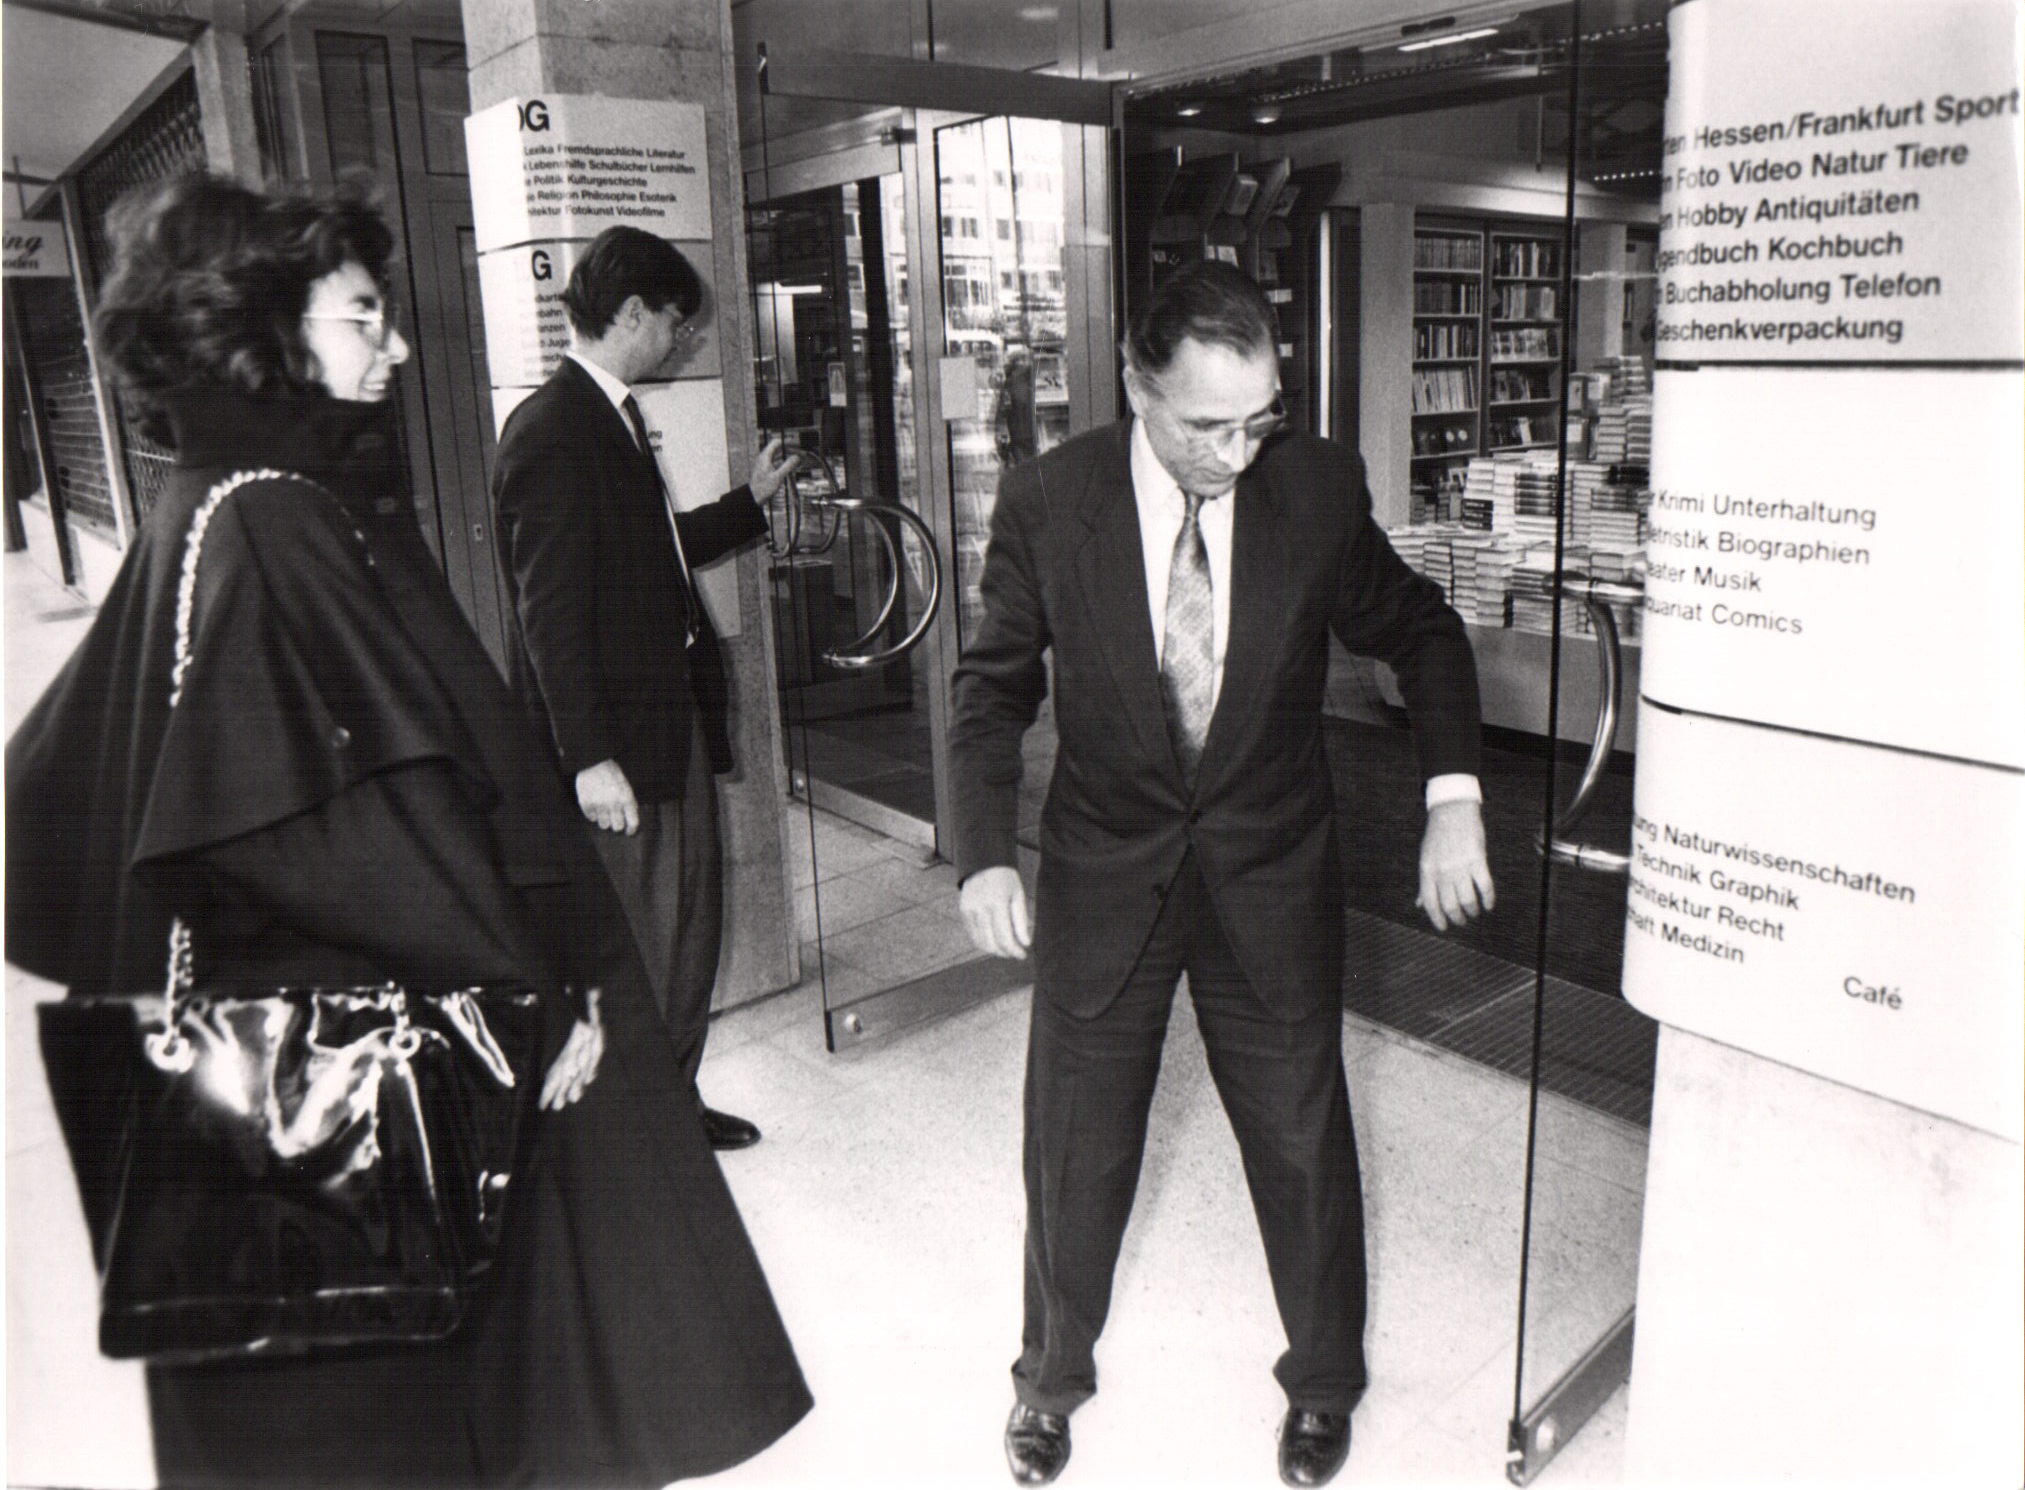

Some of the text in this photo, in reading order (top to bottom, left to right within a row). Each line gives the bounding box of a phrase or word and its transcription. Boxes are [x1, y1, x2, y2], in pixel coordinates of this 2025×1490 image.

[1693, 100, 1924, 149] Hessen/Frankfurt
[1934, 88, 2020, 125] Sport
[557, 145, 644, 159] Fremdsprachliche
[646, 148, 685, 160] Literatur
[589, 160, 648, 173] Schulbücher
[1677, 164, 1720, 189] Foto
[1729, 160, 1802, 185] Video
[1811, 151, 1888, 179] Natur
[1896, 142, 1969, 170] Tiere
[533, 175, 563, 187] Politik
[567, 175, 648, 189] Kulturgeschichte
[537, 190, 579, 202] Religion
[581, 190, 637, 202] Philosophie
[639, 192, 677, 203] Esoterik
[565, 205, 614, 217] Fotokunst
[616, 206, 666, 217] Videofilme
[1677, 201, 1748, 229] Hobby
[1754, 190, 1920, 224] Antiquitäten
[1768, 230, 1904, 261] Kochbuch
[1666, 277, 1831, 305] Buchabholung
[1840, 272, 1941, 300] Telefon
[1658, 490, 1704, 513] Krimi
[1714, 494, 1876, 532] Unterhaltung
[1718, 531, 1870, 565] Biographien
[1694, 565, 1761, 592] Musik
[1711, 603, 1804, 635] Comics
[1664, 824, 1916, 903] Naturwissenschaften
[1709, 870, 1800, 910] Graphik
[1717, 905, 1785, 941] Recht
[1661, 922, 1745, 963] Medizin
[1843, 975, 1903, 1010] Café
